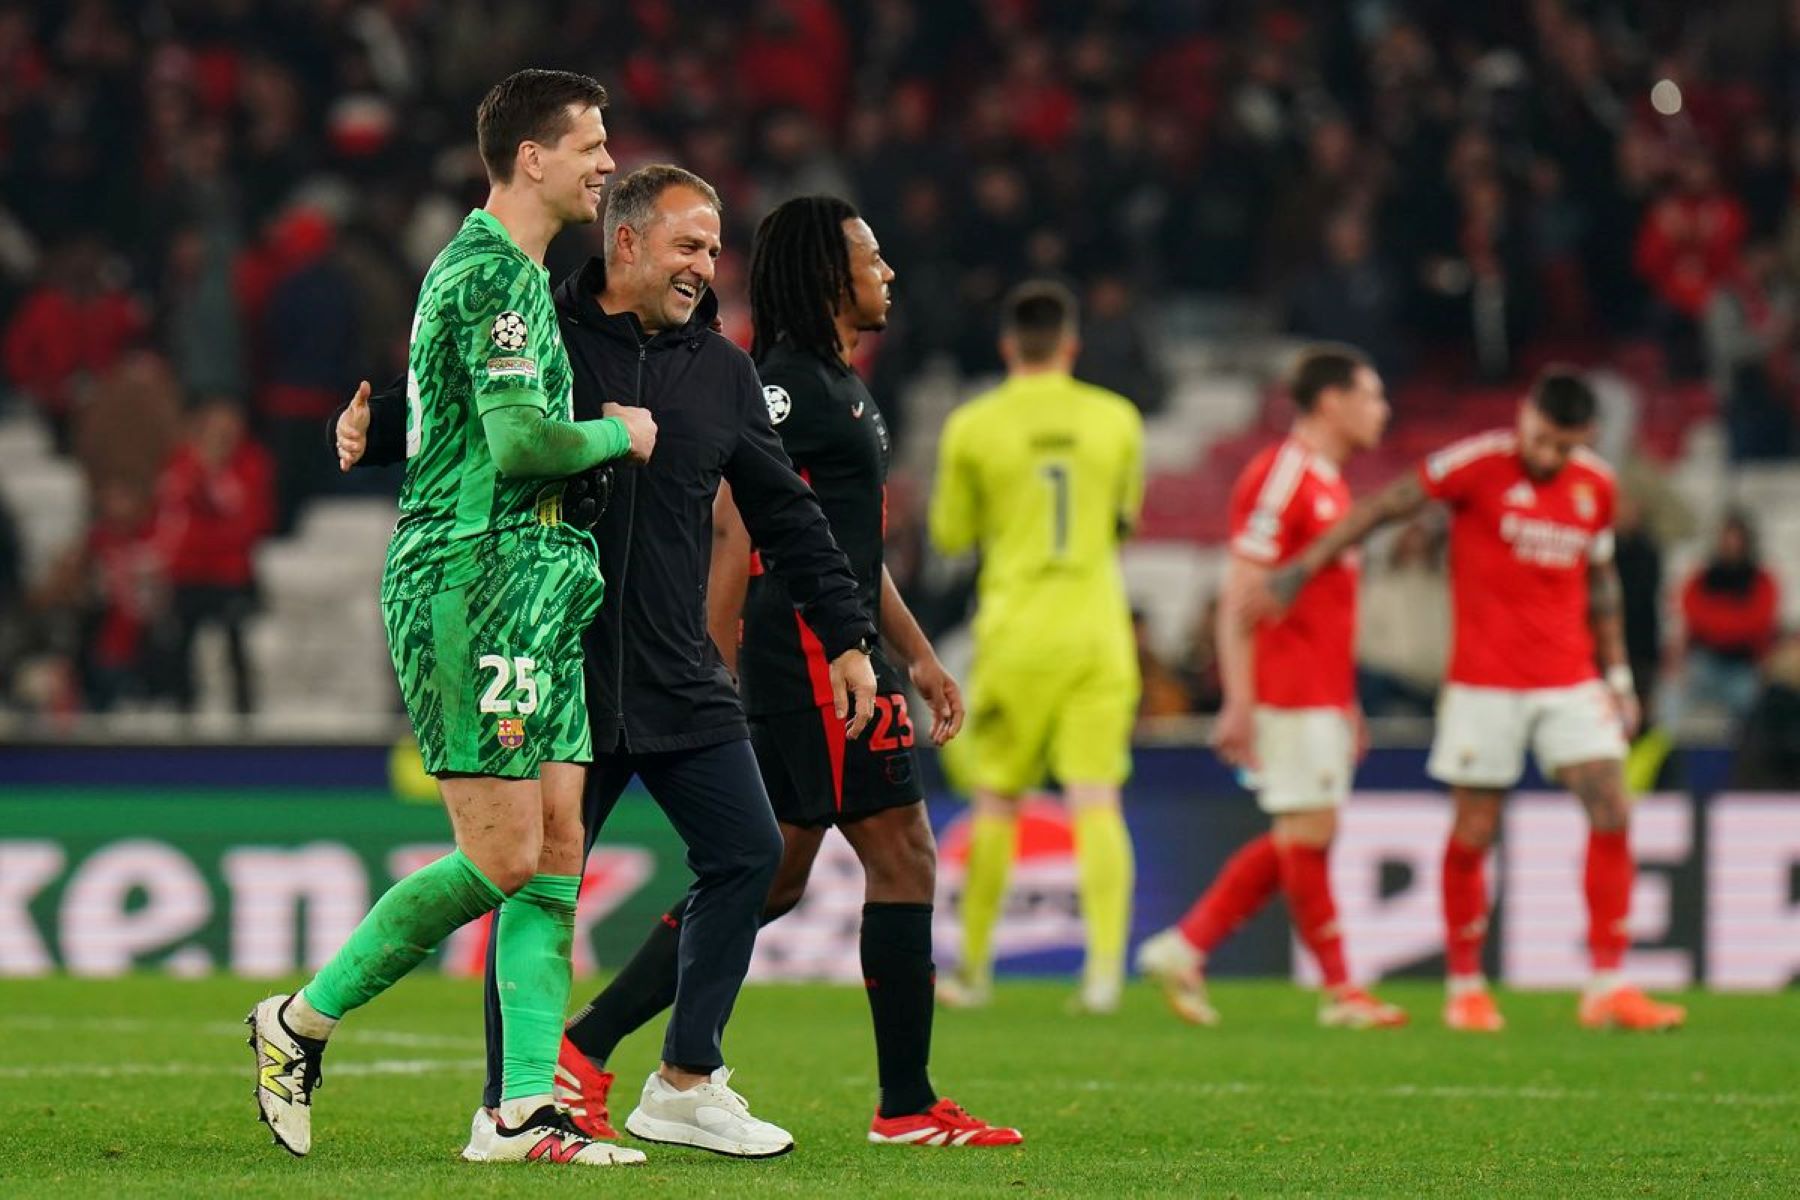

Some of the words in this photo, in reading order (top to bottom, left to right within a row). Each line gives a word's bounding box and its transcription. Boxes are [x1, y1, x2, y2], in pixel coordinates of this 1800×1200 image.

[1041, 463, 1070, 556] 1
[479, 654, 537, 715] 25
[870, 694, 914, 751] 23
